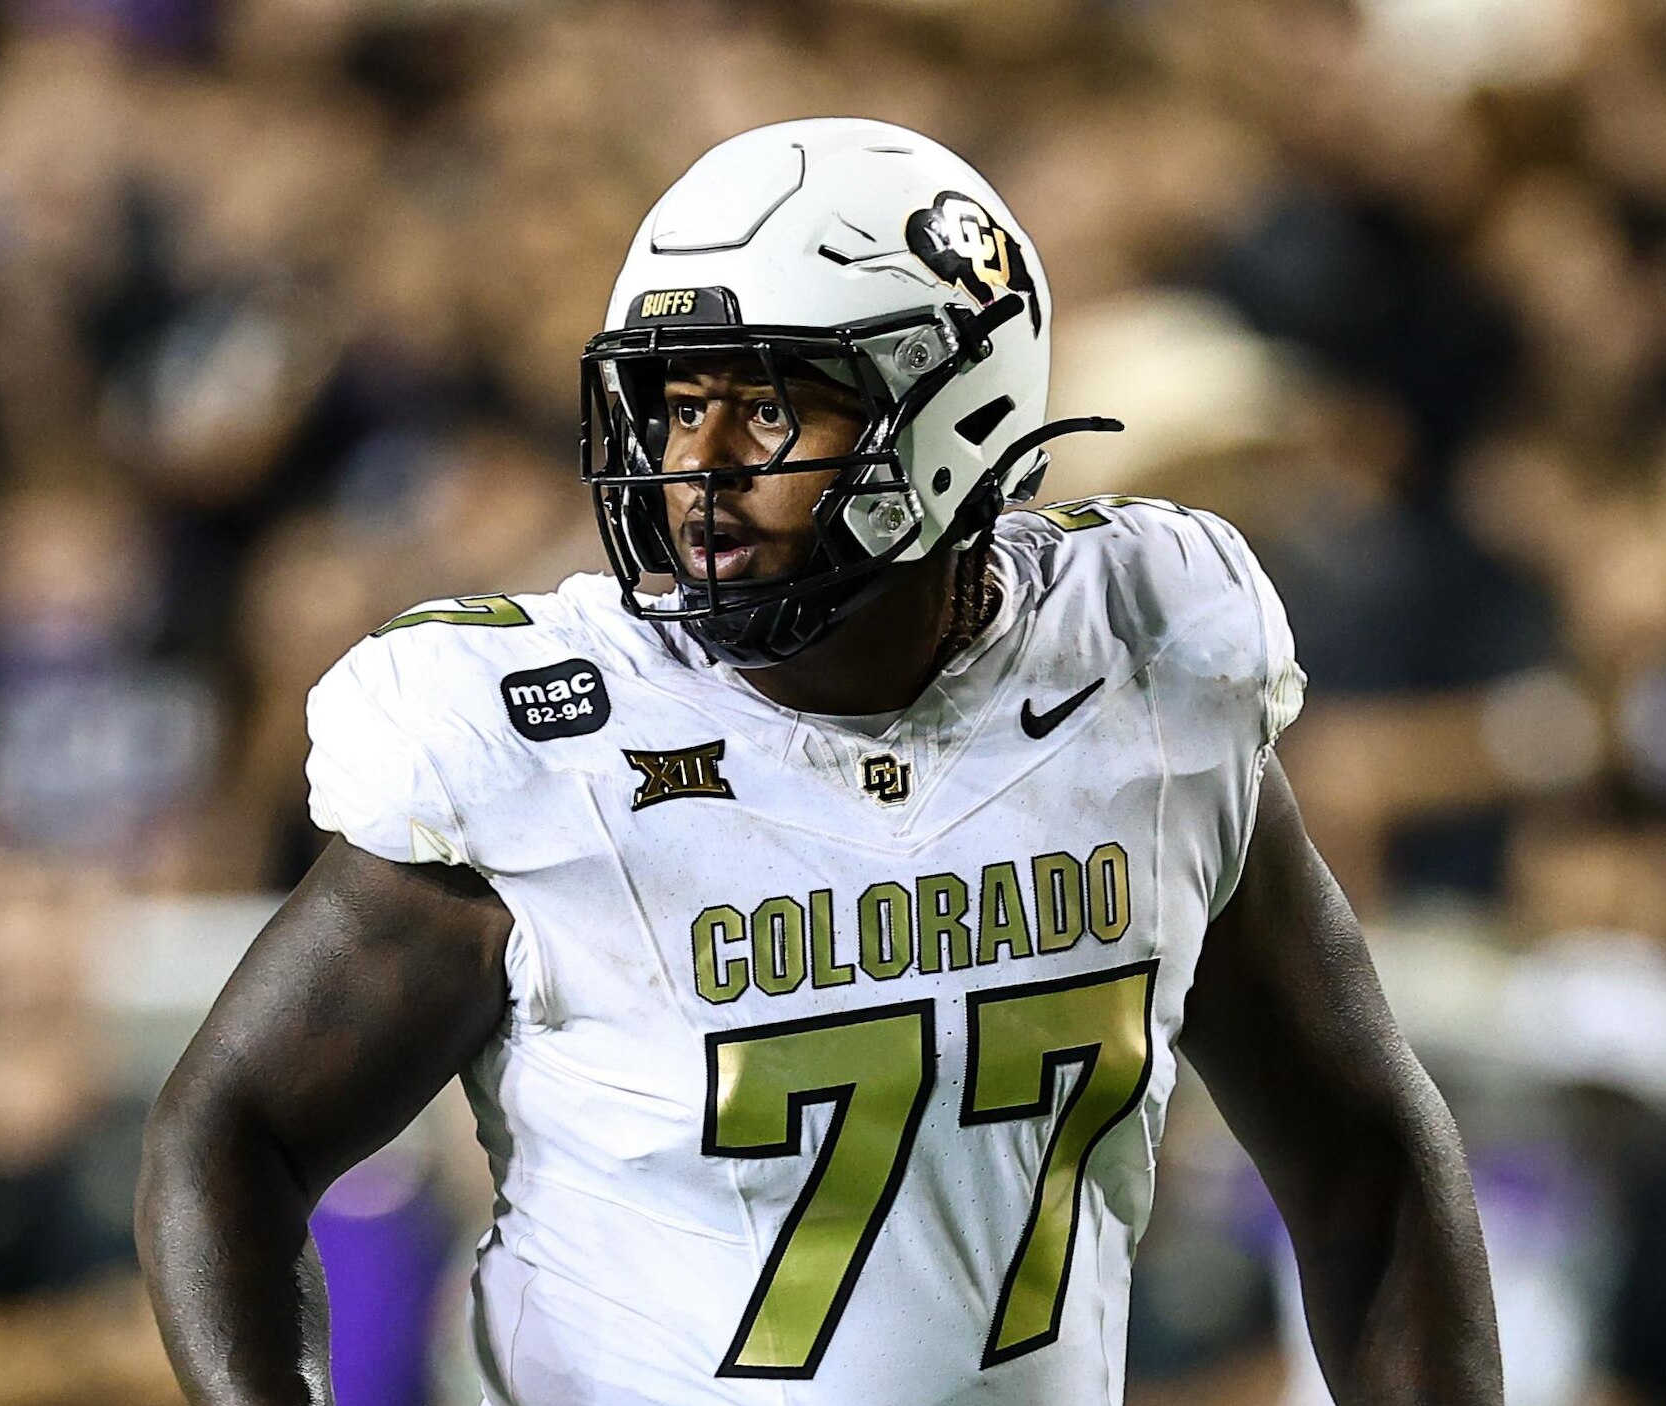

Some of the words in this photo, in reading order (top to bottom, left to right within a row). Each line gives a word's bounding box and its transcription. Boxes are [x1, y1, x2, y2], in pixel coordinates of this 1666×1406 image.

[641, 290, 696, 318] BUFFS
[509, 671, 596, 706] mac
[526, 697, 594, 725] 82-94
[691, 841, 1131, 1005] COLORADO
[701, 956, 1161, 1380] 77
